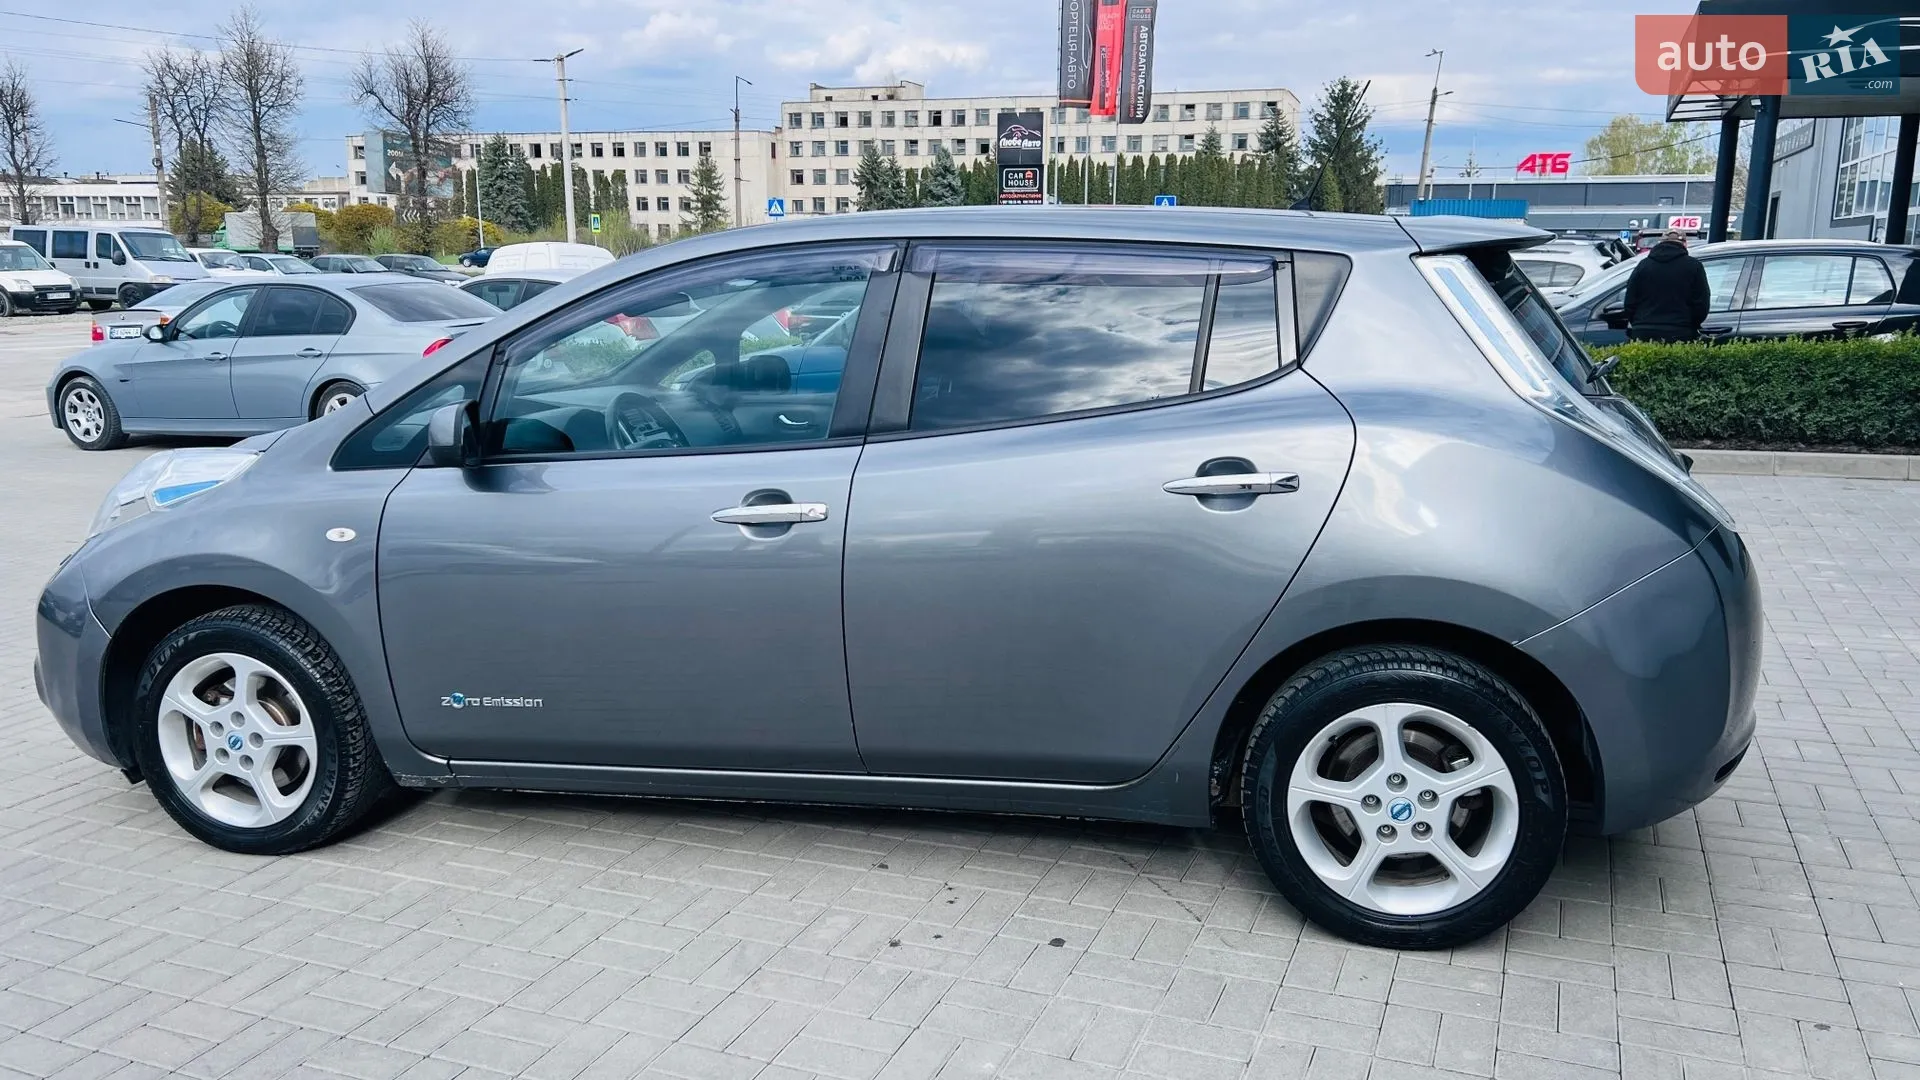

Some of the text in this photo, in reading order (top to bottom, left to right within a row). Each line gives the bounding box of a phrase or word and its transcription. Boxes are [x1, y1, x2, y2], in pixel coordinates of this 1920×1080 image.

[1067, 0, 1079, 89] ОРТЕЦЯ-АВТО
[1136, 25, 1149, 118] АВТОЗАПЧАСТИНИ
[482, 696, 544, 707] Emission
